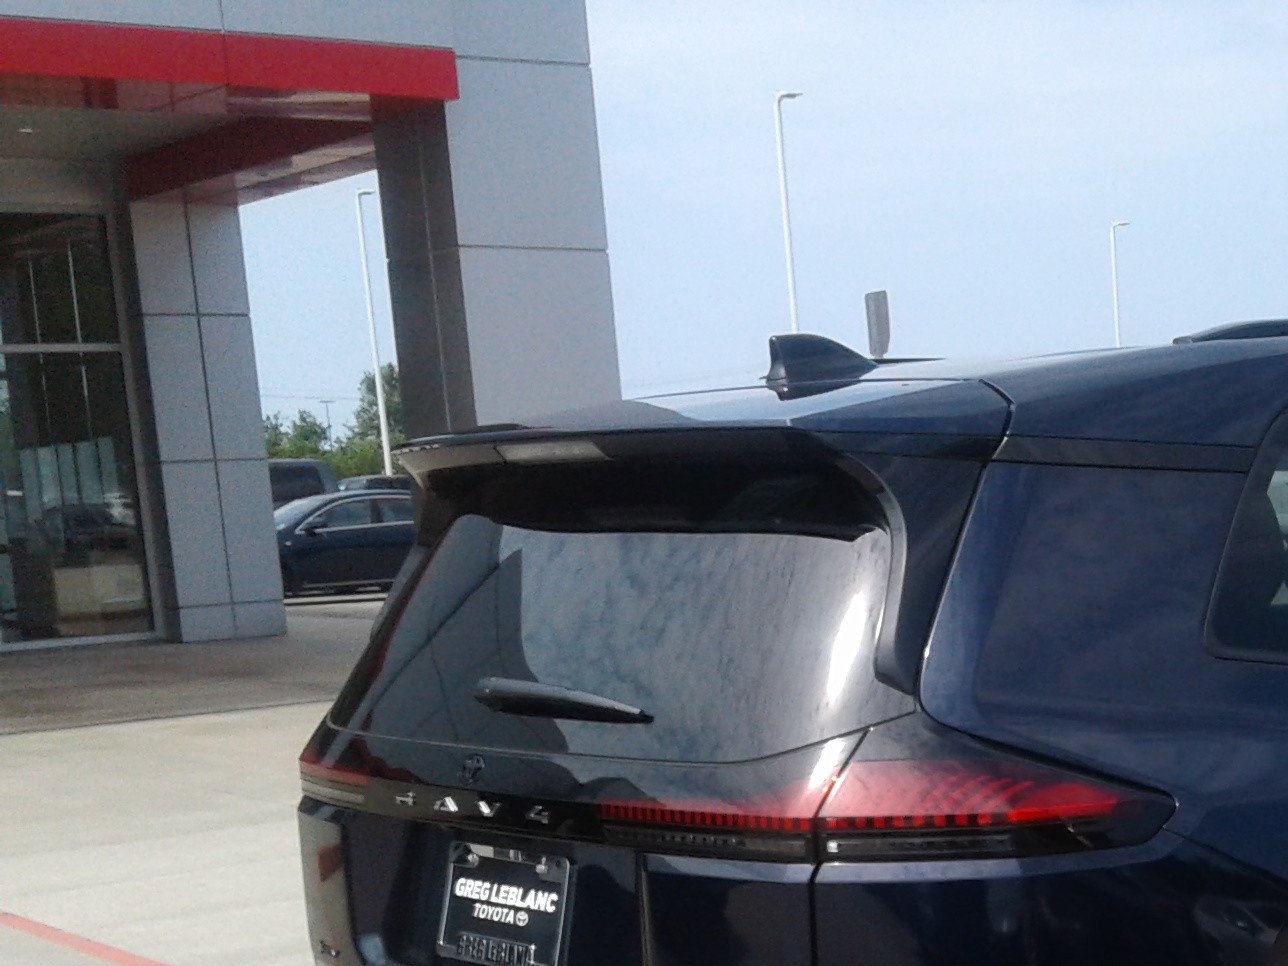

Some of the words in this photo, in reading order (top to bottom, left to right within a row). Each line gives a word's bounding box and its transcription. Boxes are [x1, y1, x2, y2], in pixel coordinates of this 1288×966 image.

[454, 877, 491, 901] GREG
[490, 882, 559, 914] LEBLANC
[472, 902, 515, 925] TOYOTA
